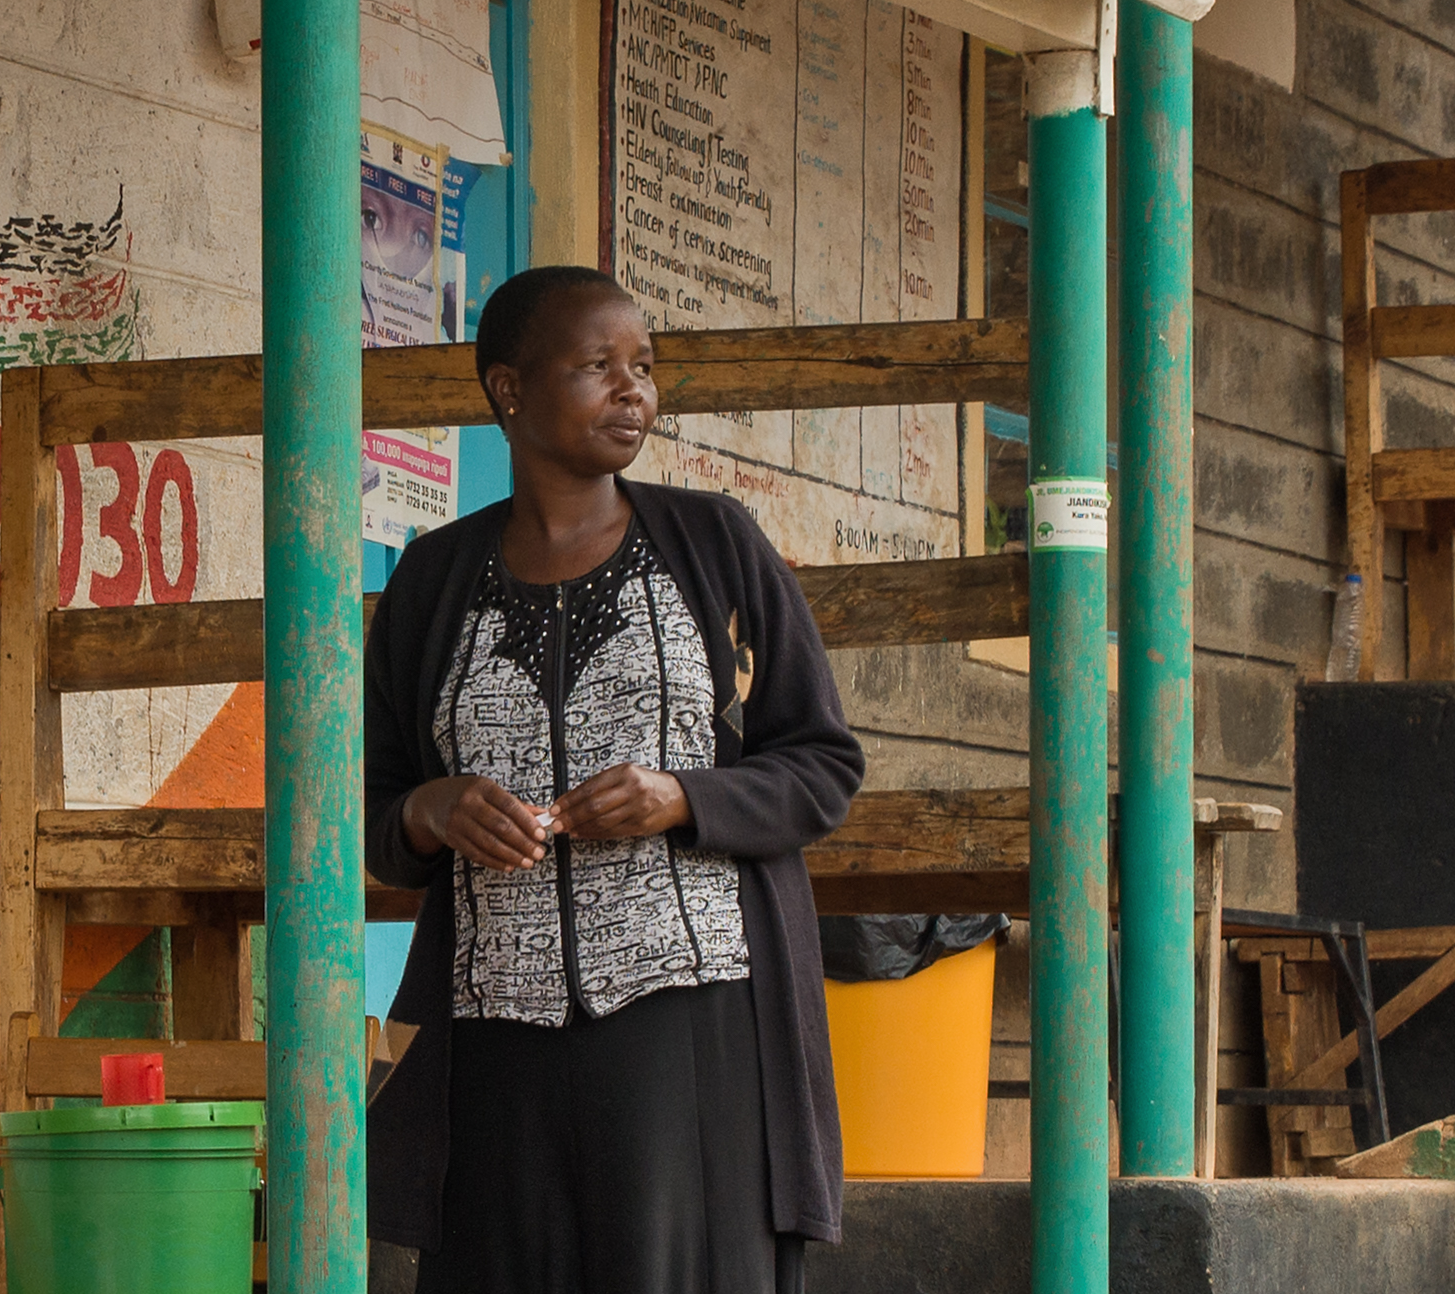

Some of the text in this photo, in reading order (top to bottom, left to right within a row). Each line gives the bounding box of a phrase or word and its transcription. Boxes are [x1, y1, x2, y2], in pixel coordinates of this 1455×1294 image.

[626, 64, 713, 128] Health Education
[626, 97, 647, 130] HIV
[714, 134, 749, 187] Testing
[626, 129, 663, 182] Elderly
[625, 196, 664, 235] Cancer
[669, 219, 679, 249] of
[626, 162, 732, 231] Breast examination
[625, 260, 703, 314] Nutrition Care
[372, 439, 401, 460] 100,000
[439, 491, 448, 504] 35
[835, 519, 878, 555] 8:00AM
